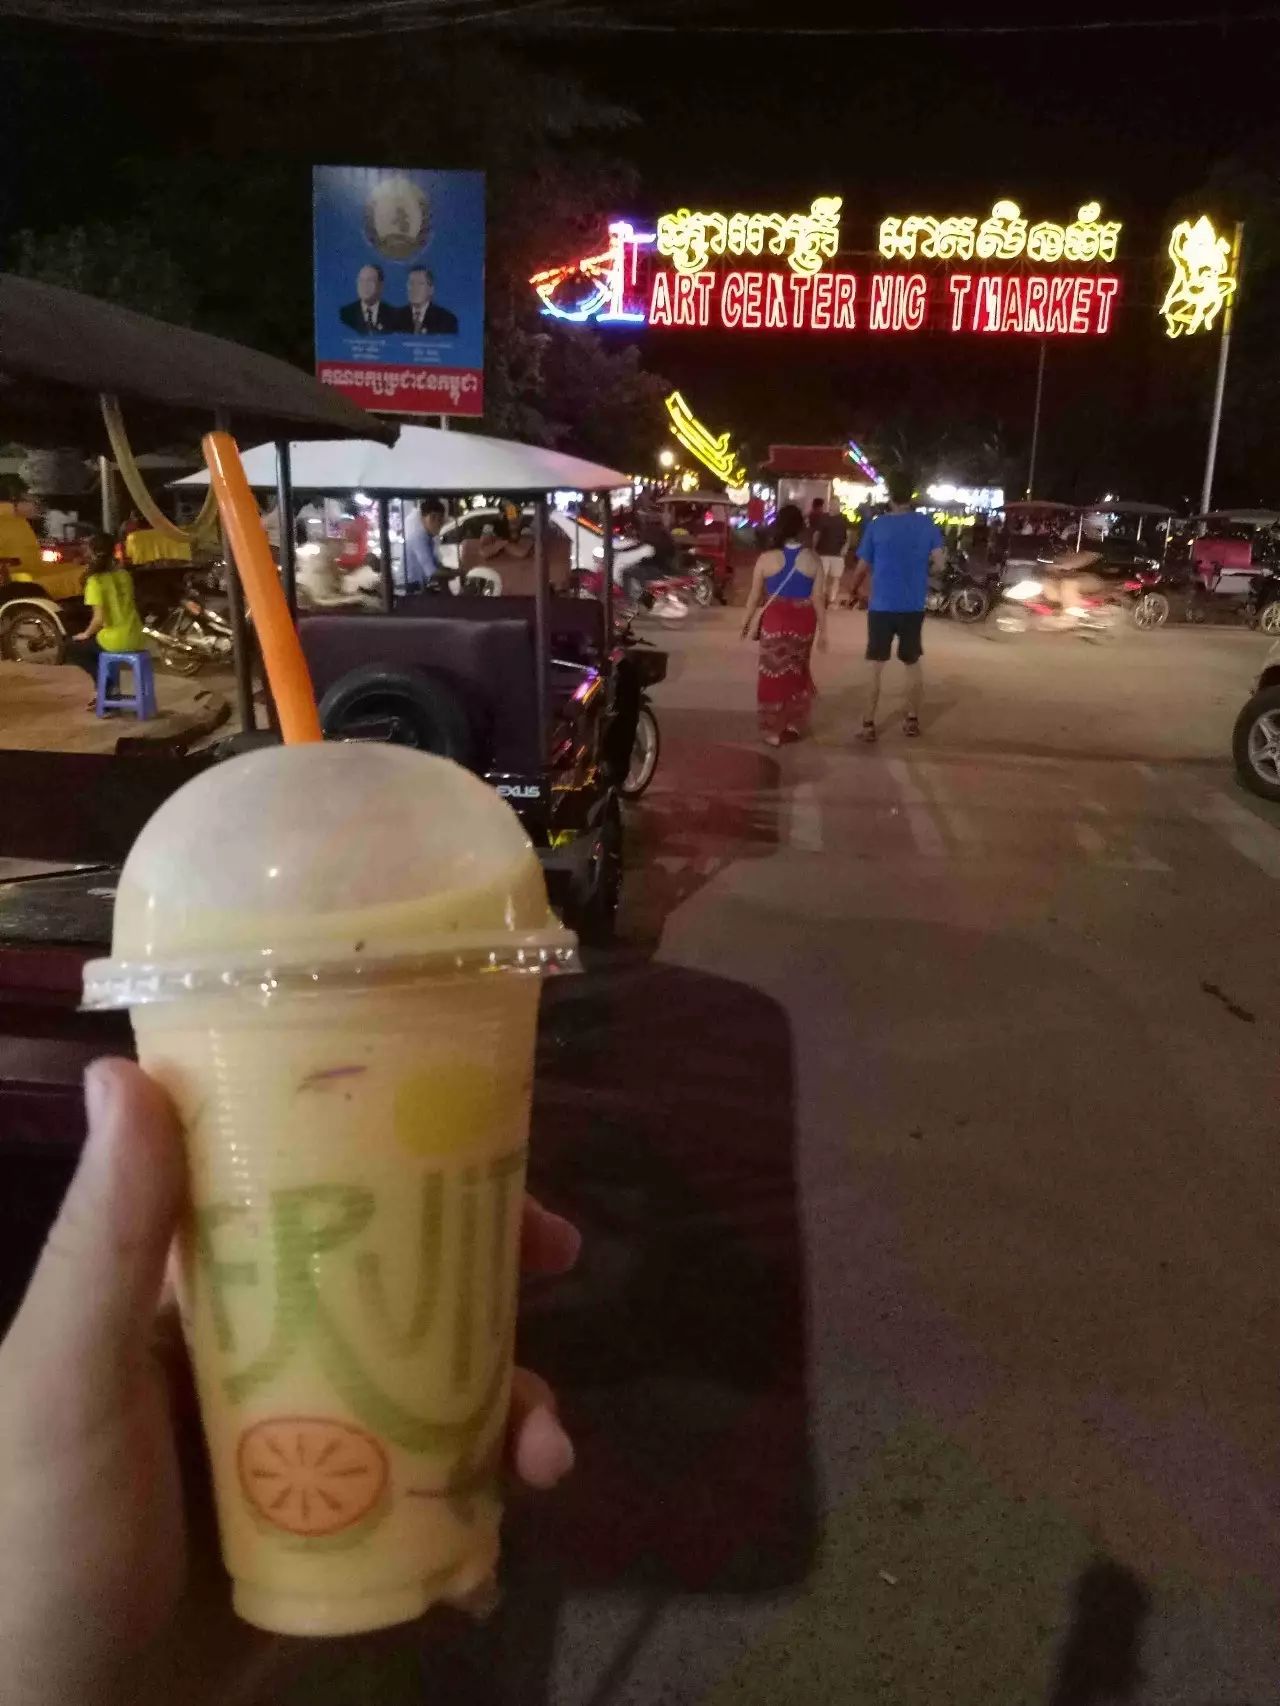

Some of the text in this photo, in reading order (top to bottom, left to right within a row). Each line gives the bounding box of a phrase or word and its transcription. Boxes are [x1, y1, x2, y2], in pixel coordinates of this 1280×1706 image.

[649, 271, 715, 326] ART
[721, 272, 856, 329] CENTER
[973, 276, 1118, 334] MARKET
